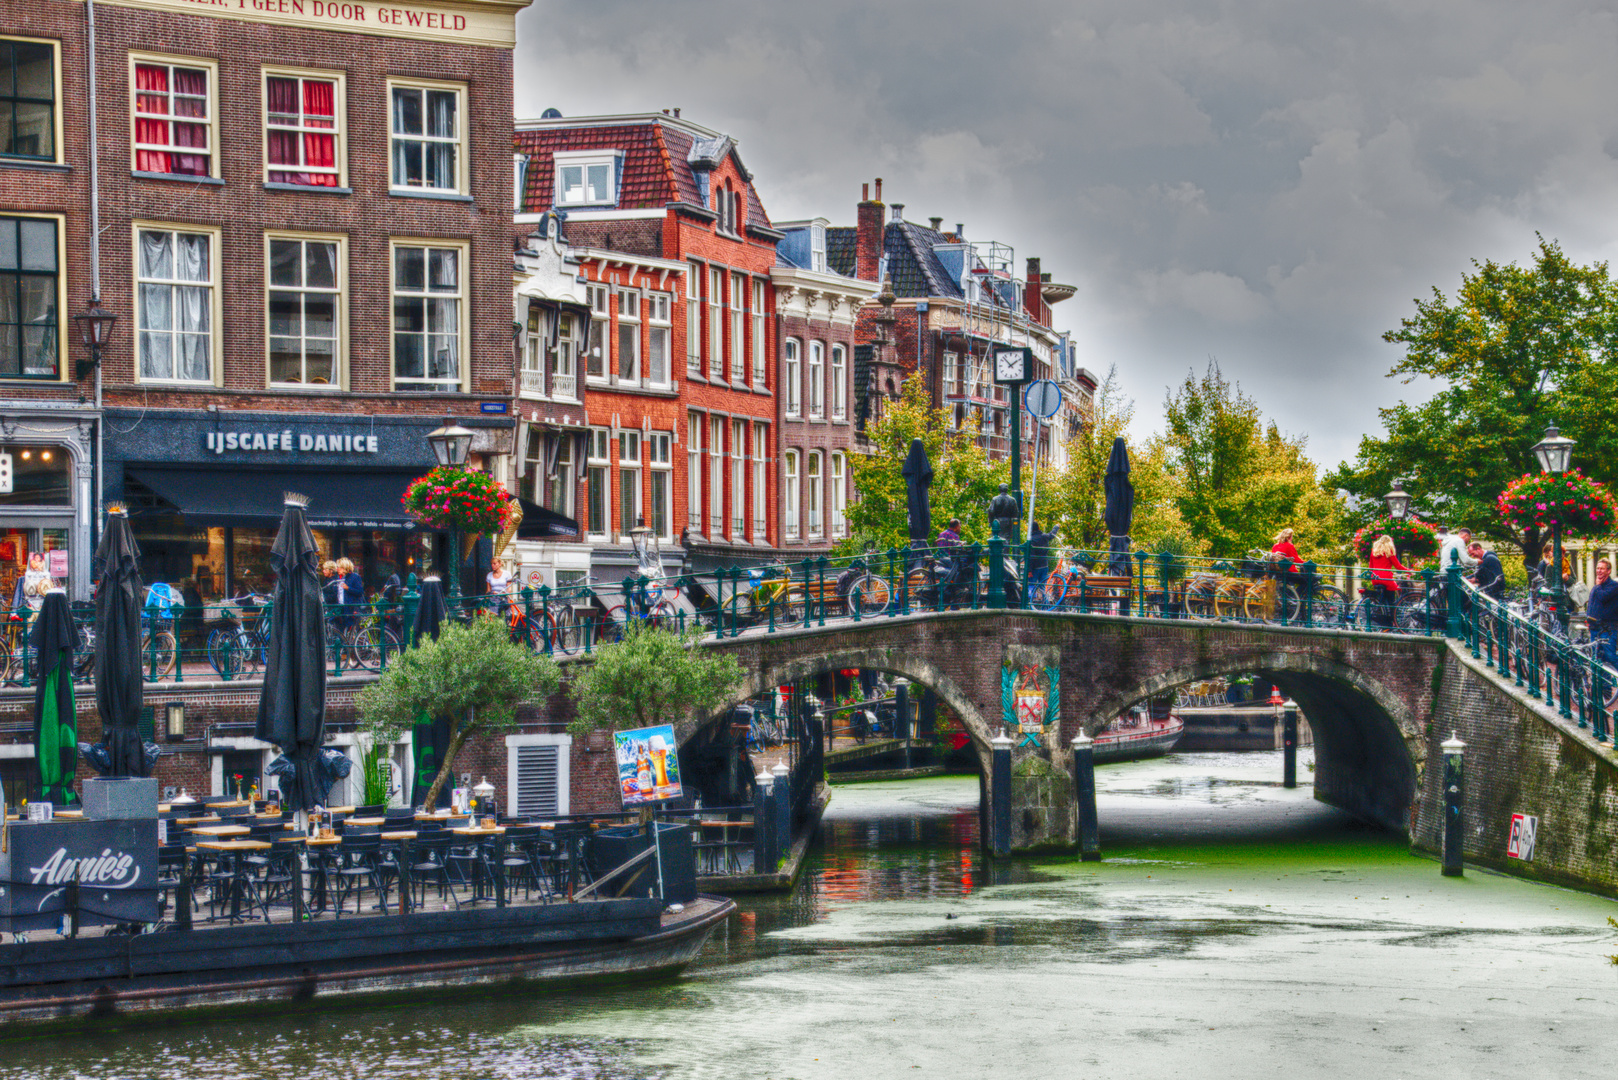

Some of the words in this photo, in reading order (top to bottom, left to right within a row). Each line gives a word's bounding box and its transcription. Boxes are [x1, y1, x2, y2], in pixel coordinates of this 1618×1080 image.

[252, 0, 305, 15] GEEN
[313, 1, 366, 21] DOOR
[378, 8, 466, 31] GEWELD
[207, 430, 293, 454] IJSCAFÉ
[299, 434, 378, 452] DANICE
